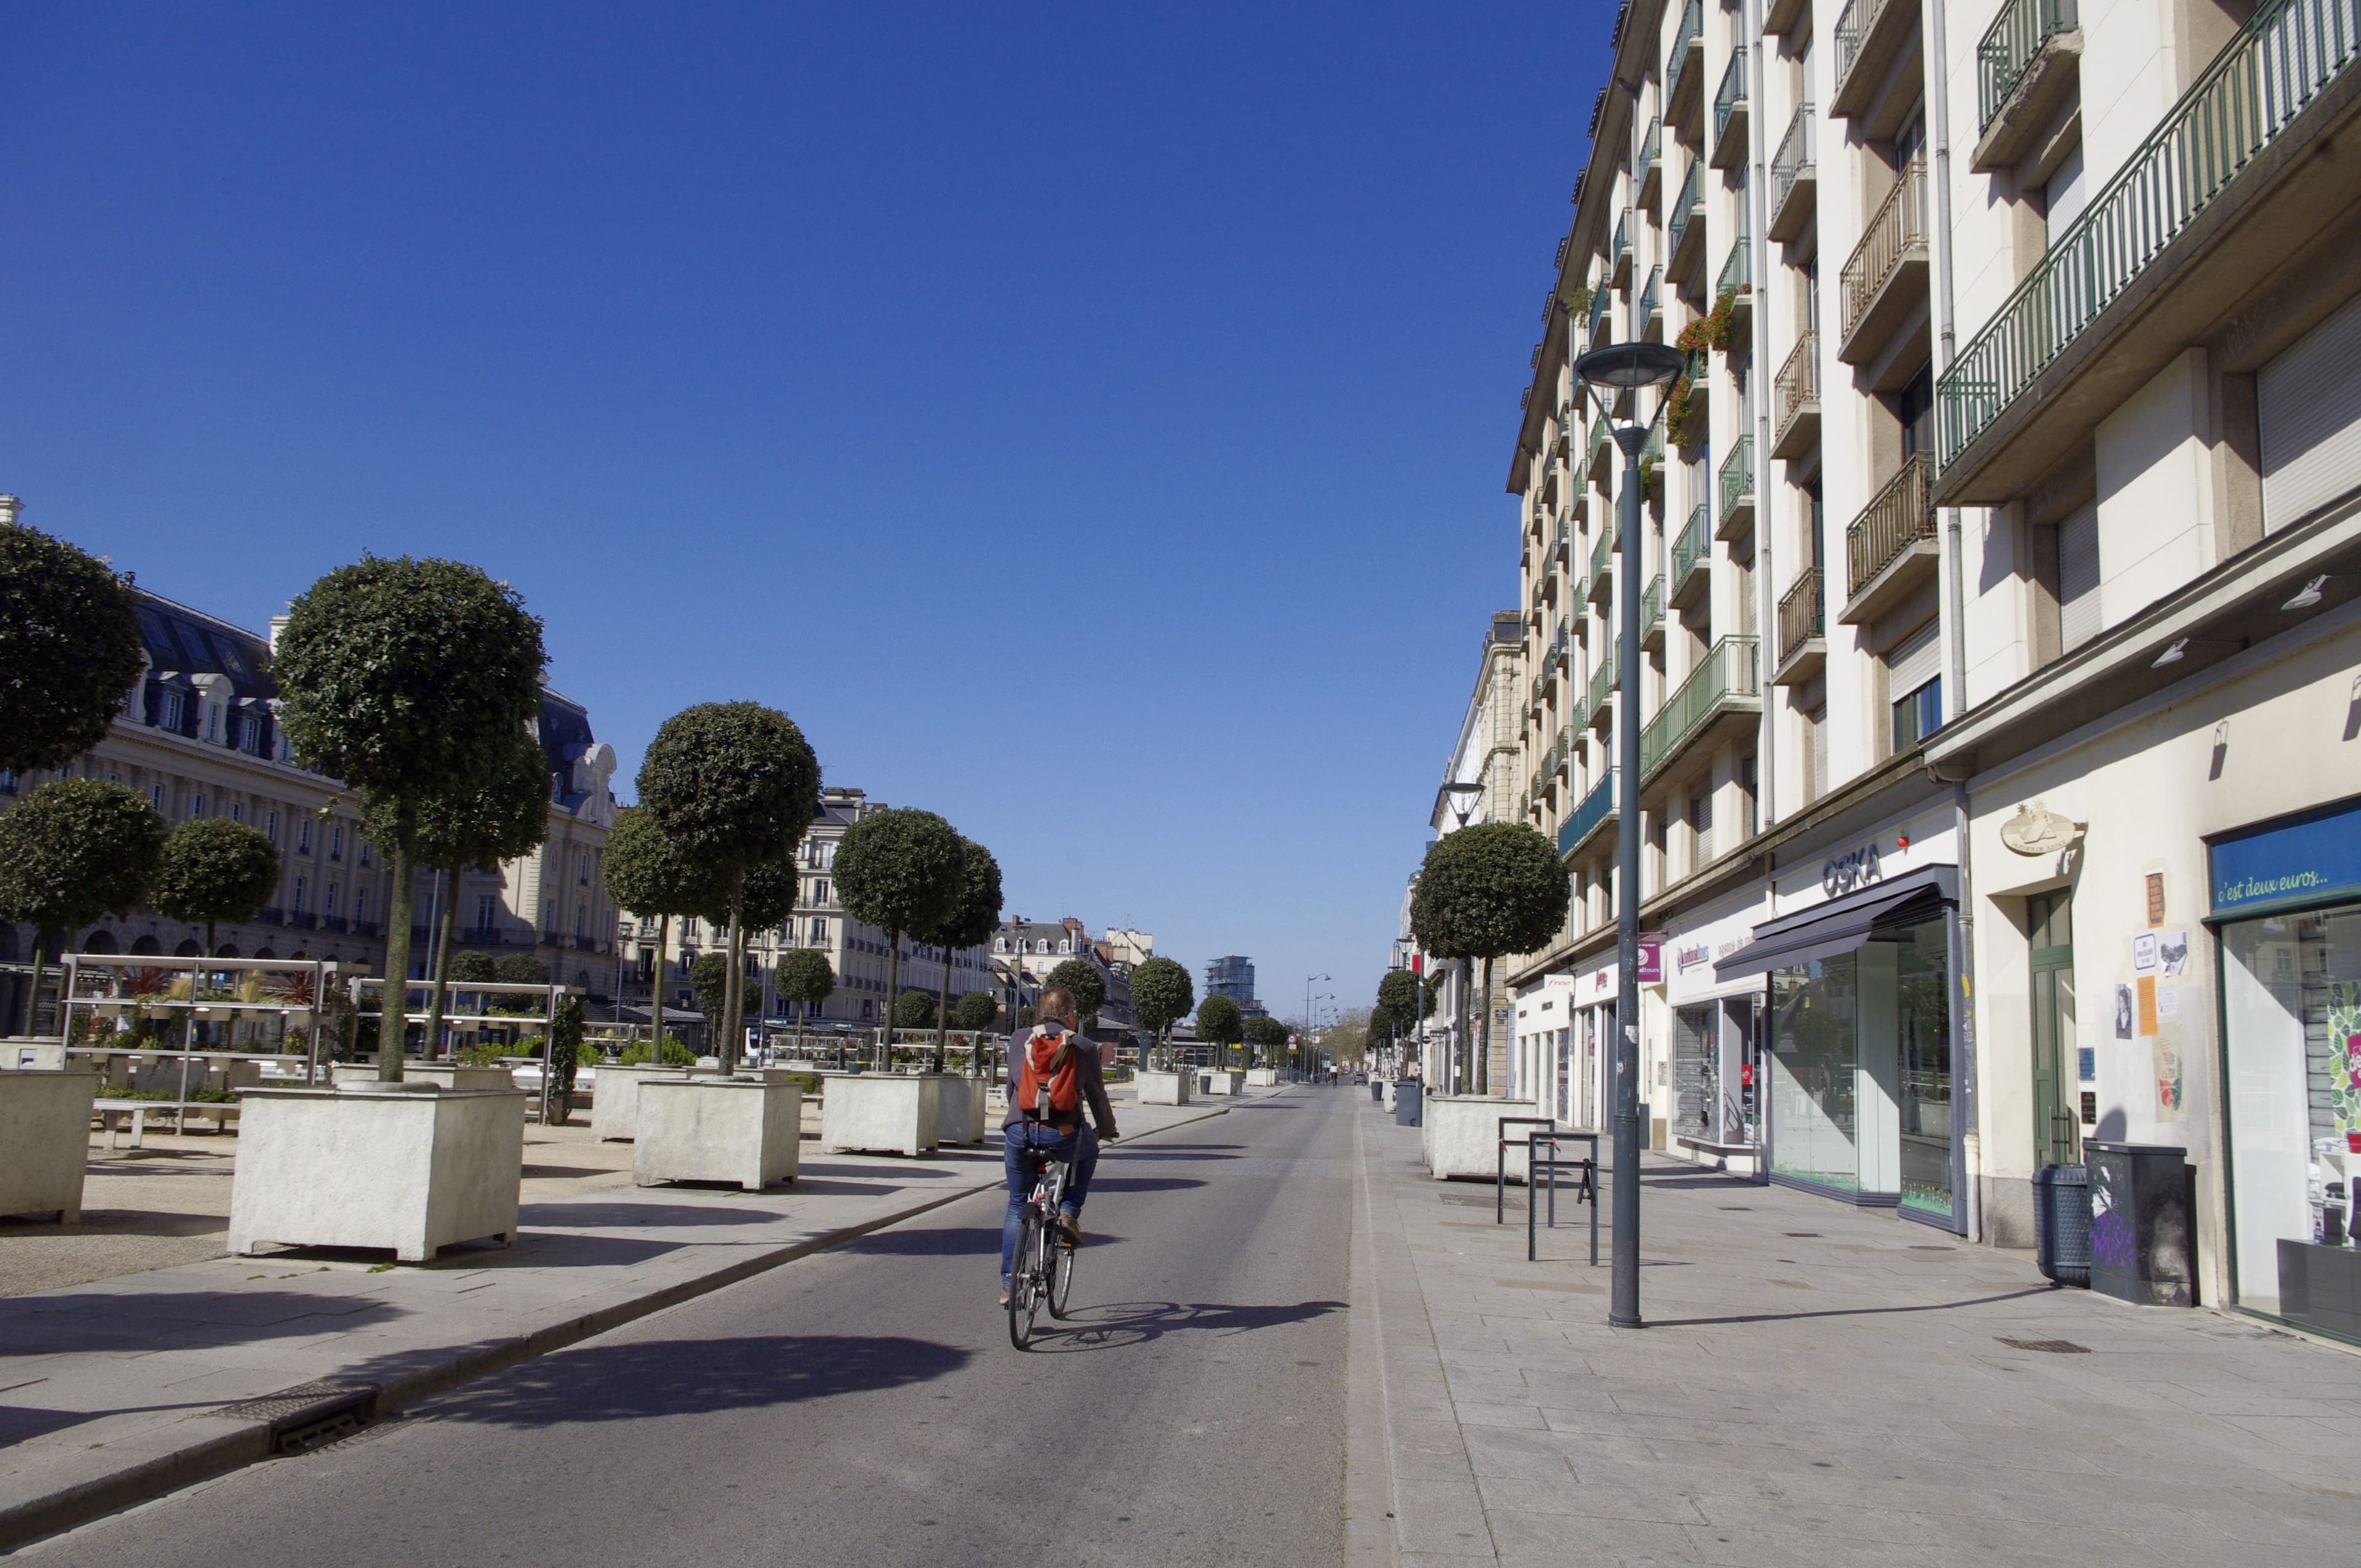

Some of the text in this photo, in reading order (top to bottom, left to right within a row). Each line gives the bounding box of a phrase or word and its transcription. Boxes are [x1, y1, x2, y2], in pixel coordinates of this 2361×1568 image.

[1822, 844, 1882, 898] OSKA
[2218, 882, 2244, 903] c'est
[2245, 877, 2278, 897] deux
[1548, 979, 1571, 988] free
